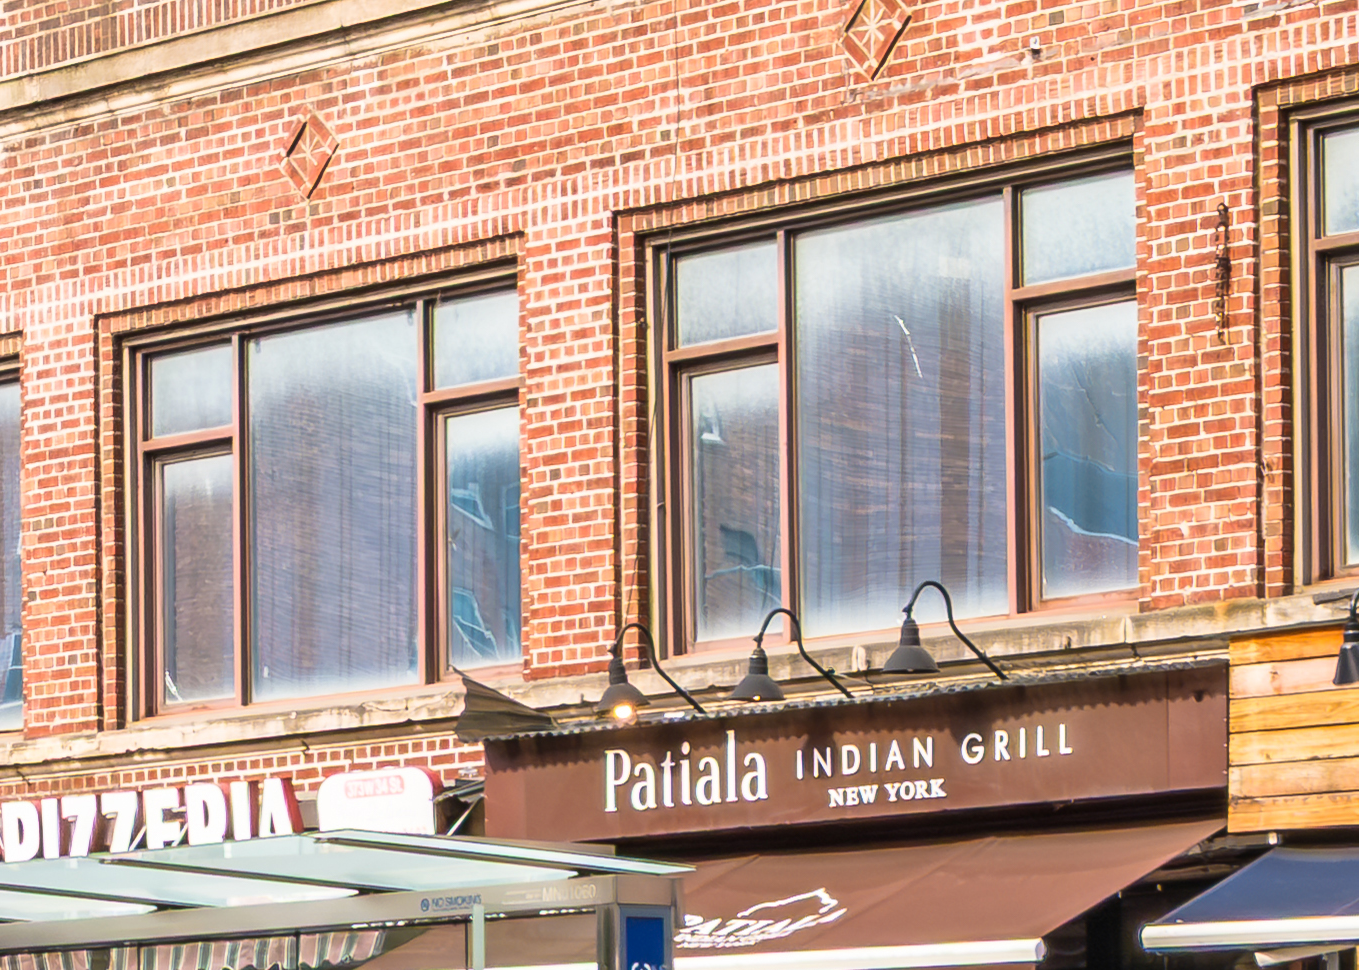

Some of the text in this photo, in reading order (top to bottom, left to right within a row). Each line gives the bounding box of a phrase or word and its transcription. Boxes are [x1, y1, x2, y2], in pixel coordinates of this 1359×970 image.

[605, 730, 769, 812] Patiala
[797, 723, 1073, 780] INDIAN GRILL
[829, 778, 947, 807] NEW YORK
